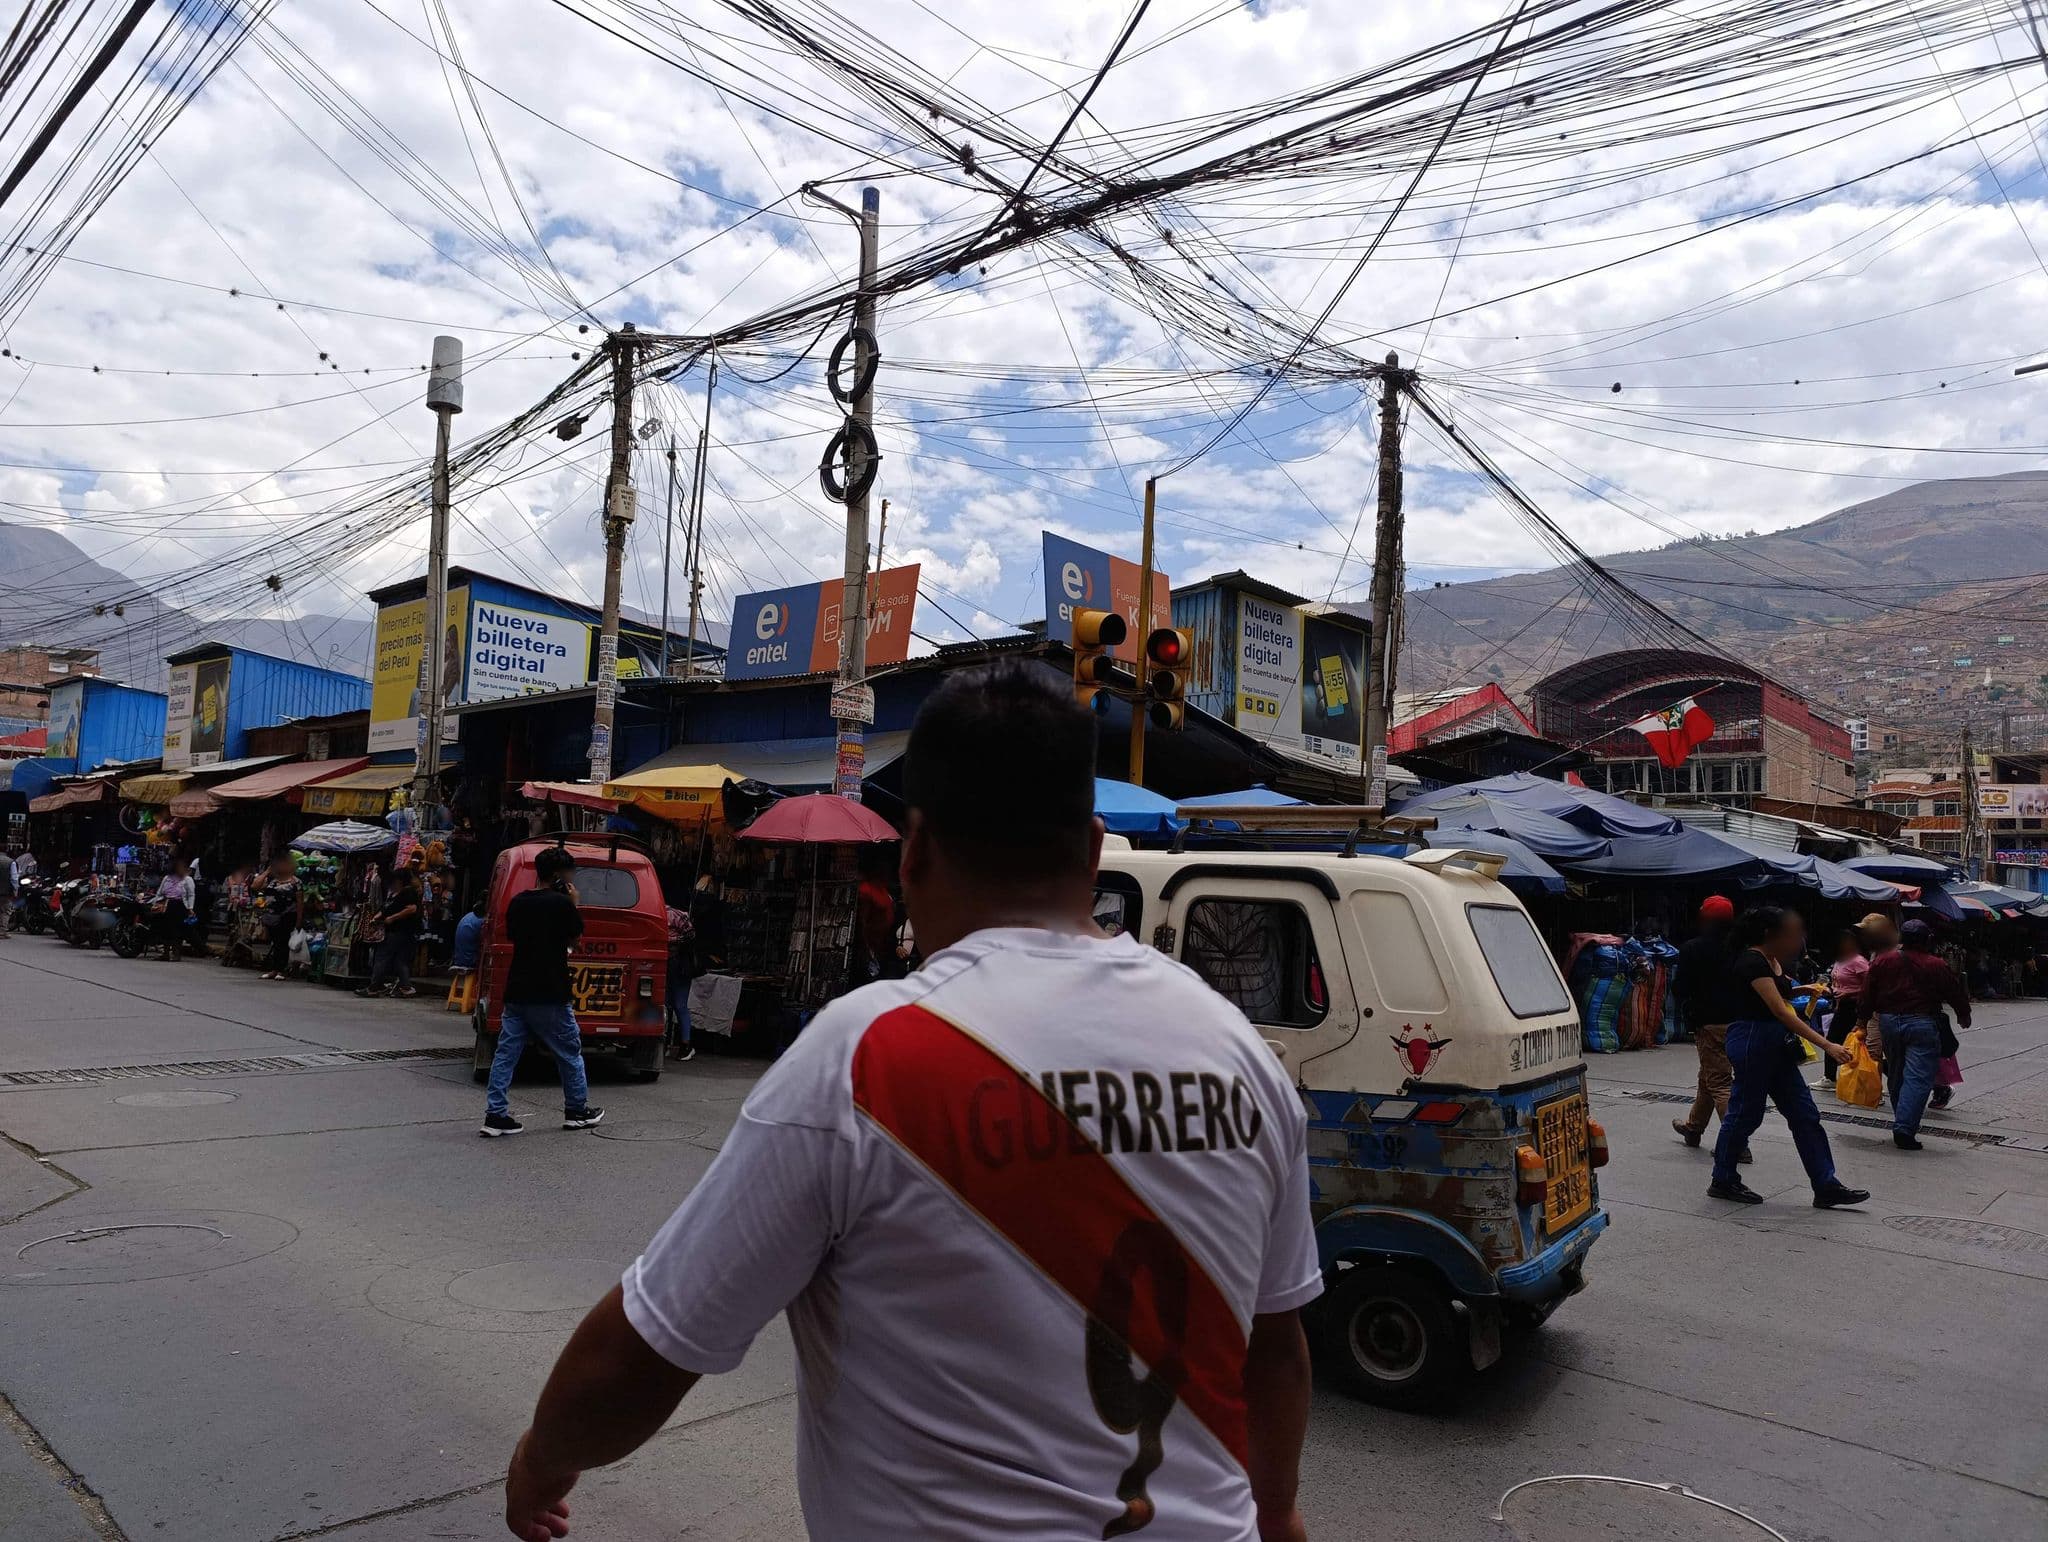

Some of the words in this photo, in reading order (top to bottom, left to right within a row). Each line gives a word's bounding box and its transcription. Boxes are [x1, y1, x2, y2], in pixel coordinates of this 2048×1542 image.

[887, 593, 909, 607] soda
[382, 615, 411, 633] Internet
[449, 603, 458, 616] el
[479, 607, 548, 635] Nueva
[1244, 600, 1283, 626] Nueva
[380, 636, 404, 655] precio
[405, 630, 423, 647] más
[477, 628, 567, 658] billetera
[1244, 621, 1293, 649] billetera
[379, 658, 391, 672] del
[392, 651, 410, 669] Perú
[476, 649, 545, 674] digital
[746, 641, 788, 665] entel
[1244, 643, 1282, 667] digital
[473, 668, 487, 677] Sin
[489, 671, 518, 682] cuenta
[520, 676, 531, 684] de
[532, 679, 557, 689] banco
[1242, 664, 1252, 674] Sin
[1253, 667, 1272, 680] cuenta
[1272, 671, 1280, 681] de
[1981, 793, 2008, 805] 19
[967, 1069, 1262, 1168] GUERRERO
